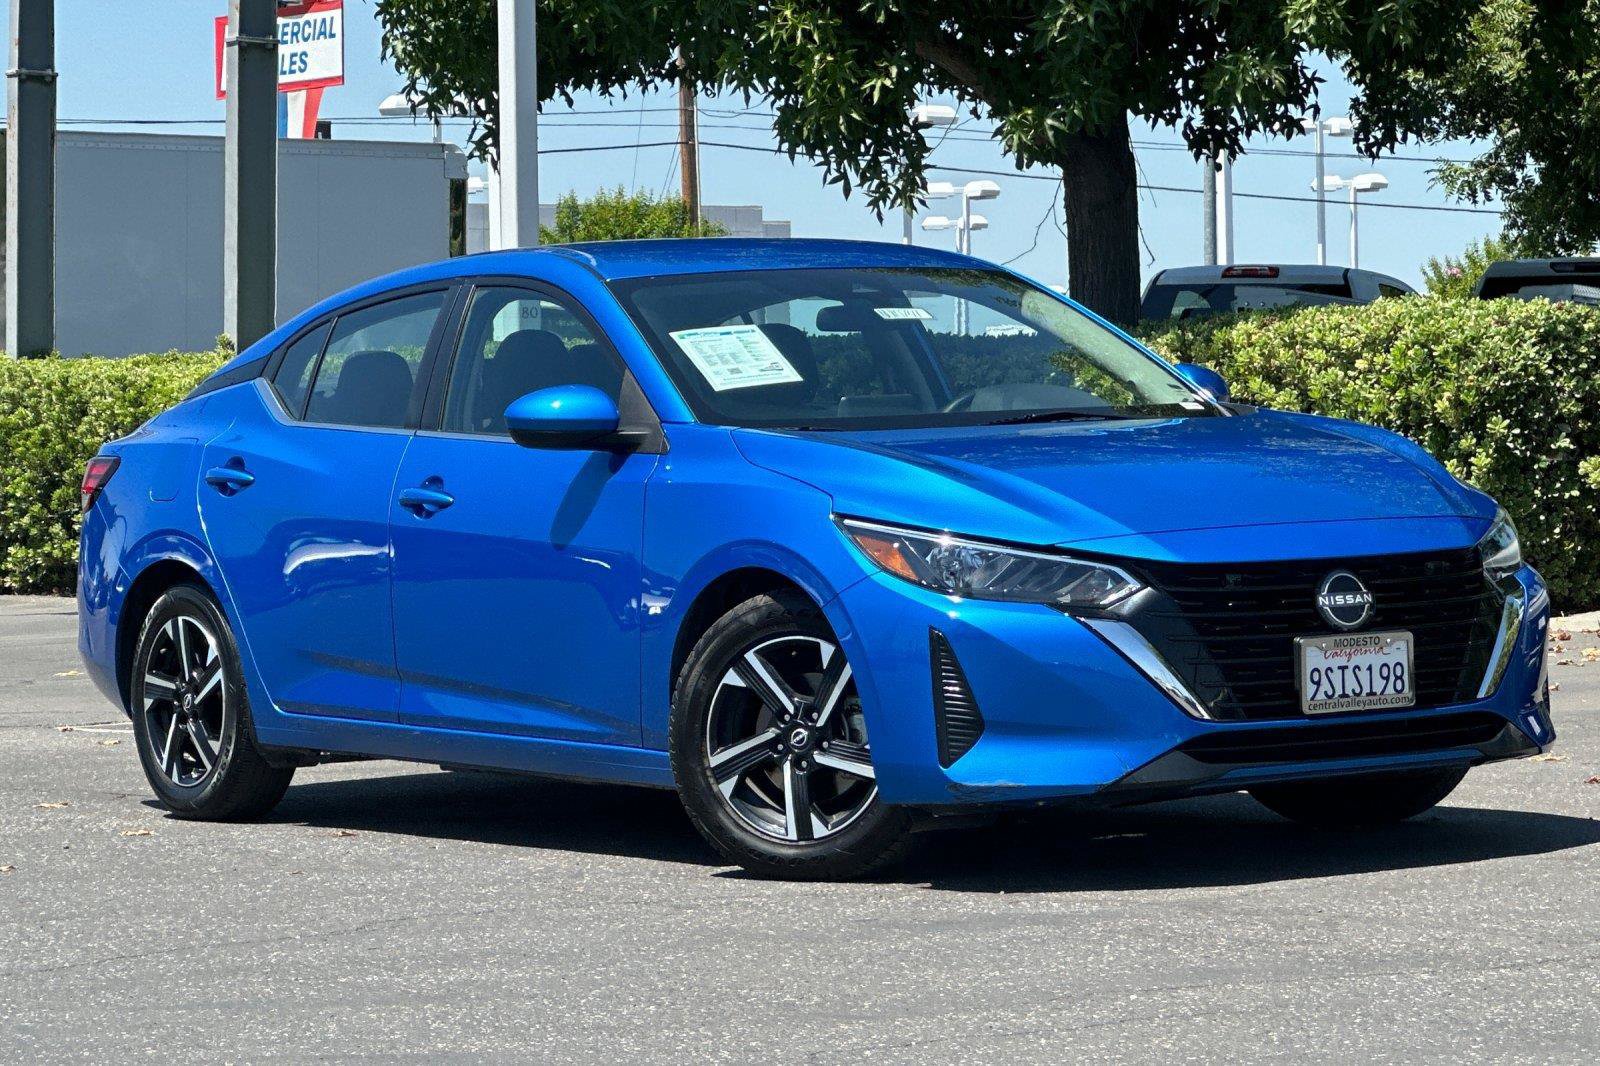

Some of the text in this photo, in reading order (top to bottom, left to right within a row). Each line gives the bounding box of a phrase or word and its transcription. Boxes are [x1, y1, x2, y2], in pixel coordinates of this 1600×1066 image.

[278, 16, 337, 46] ERCIAL
[279, 51, 308, 76] LES
[521, 306, 538, 319] 80
[1318, 593, 1372, 606] NISSAN
[1333, 636, 1380, 648] MODESTO
[1309, 661, 1405, 700] 9SIS198
[1308, 695, 1410, 712] centralvalleyauto.com
